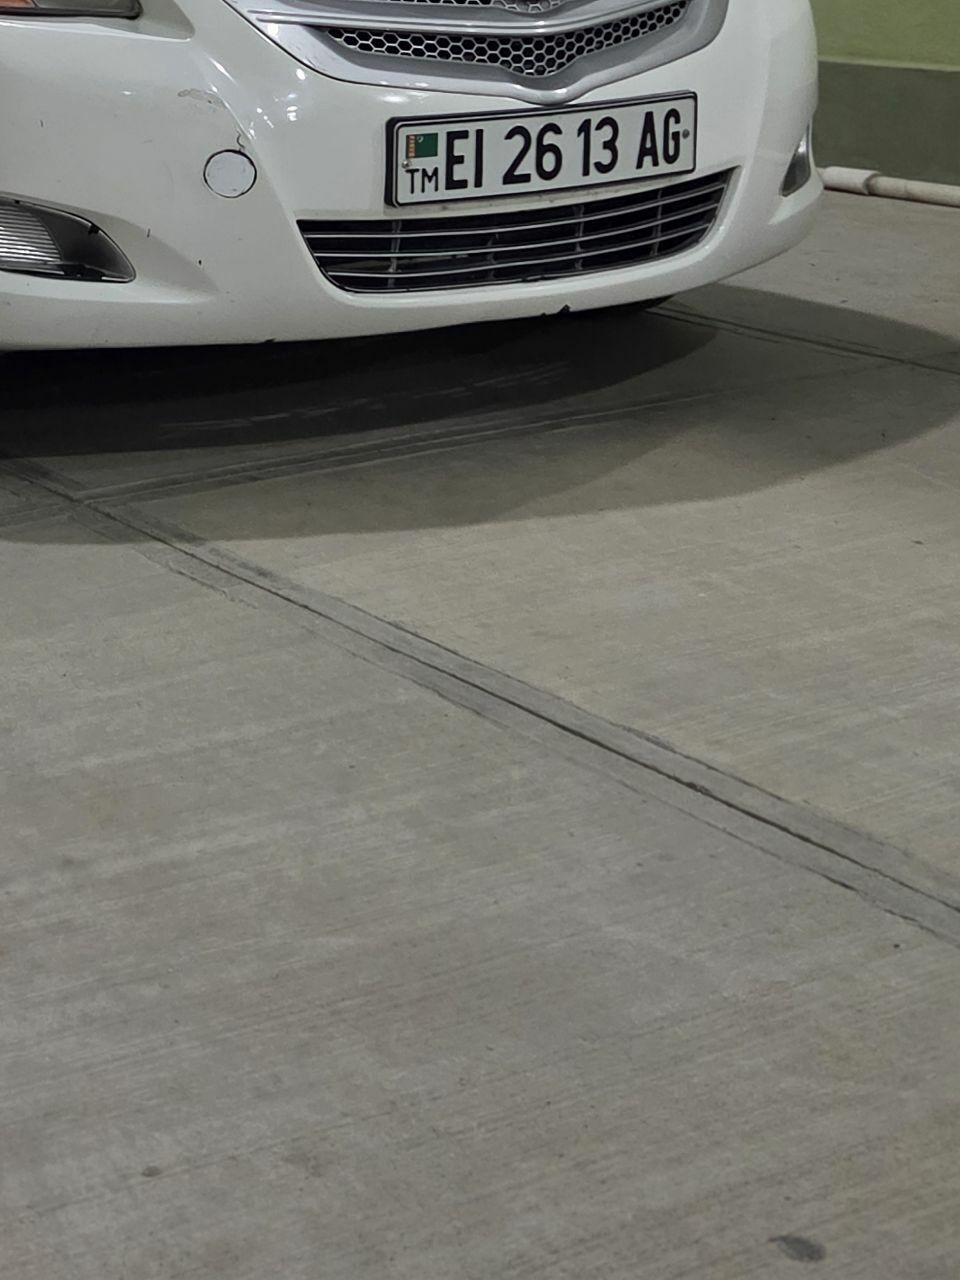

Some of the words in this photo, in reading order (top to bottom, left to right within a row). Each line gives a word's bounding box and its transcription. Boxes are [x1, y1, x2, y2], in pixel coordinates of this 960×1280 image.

[444, 128, 484, 190] EI
[502, 122, 563, 185] 26
[577, 116, 619, 177] 13
[636, 108, 681, 170] AG
[405, 167, 439, 194] TM
